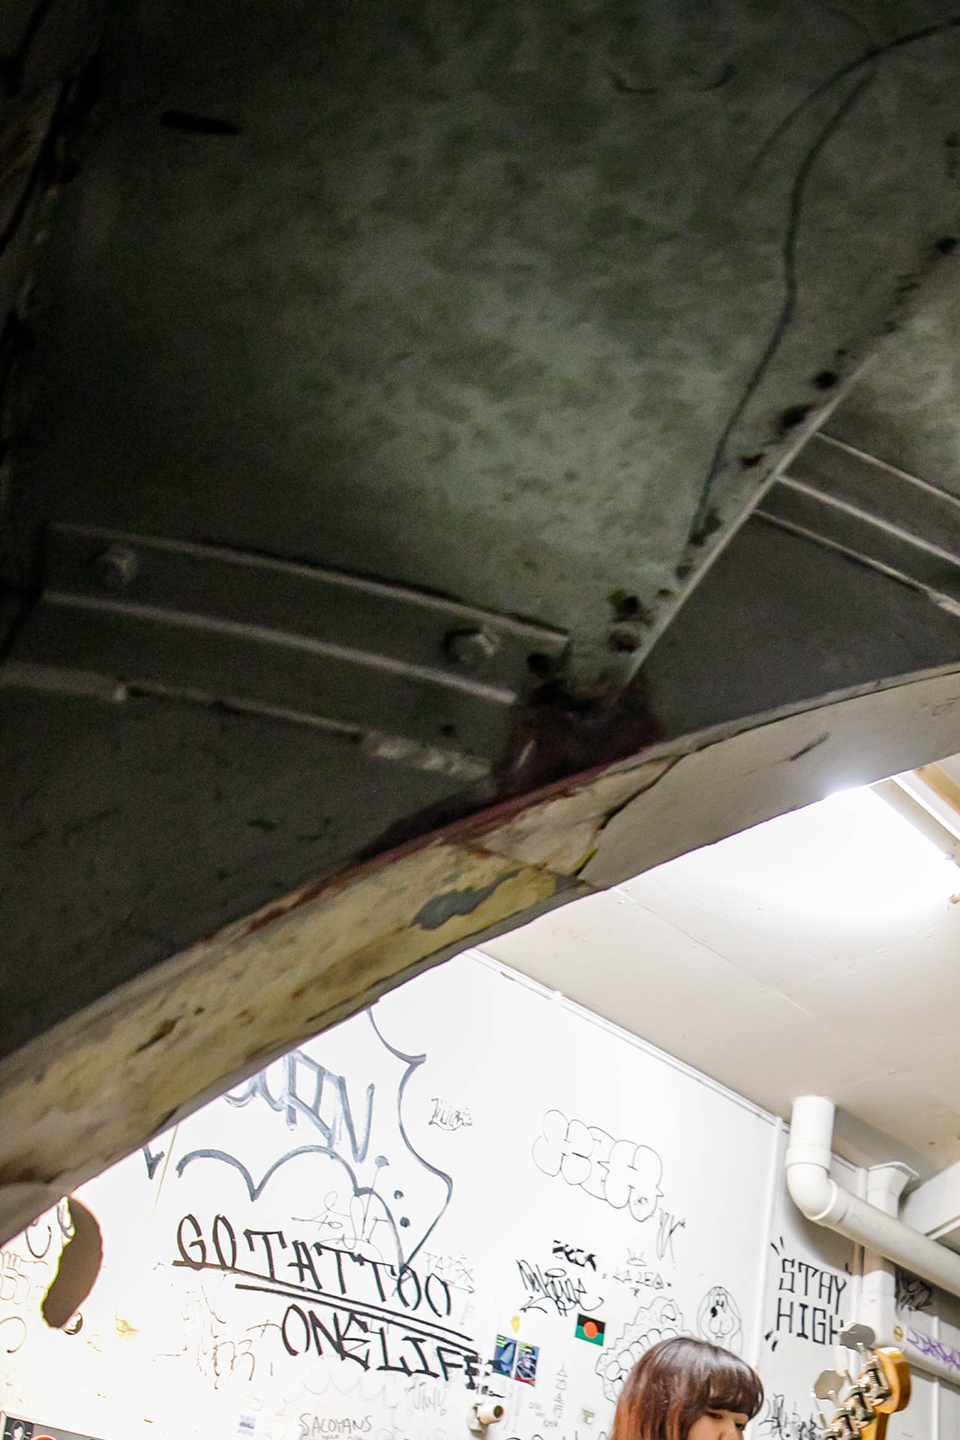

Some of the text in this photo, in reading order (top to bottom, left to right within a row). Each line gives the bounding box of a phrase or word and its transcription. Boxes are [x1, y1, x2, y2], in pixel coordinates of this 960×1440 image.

[176, 1213, 238, 1271] GO
[242, 1228, 452, 1318] TATTOO
[778, 1257, 848, 1316] STAY
[281, 1303, 490, 1392] ONE LIFE
[775, 1296, 845, 1346] HIGH
[298, 1412, 374, 1438] SACOYANS
